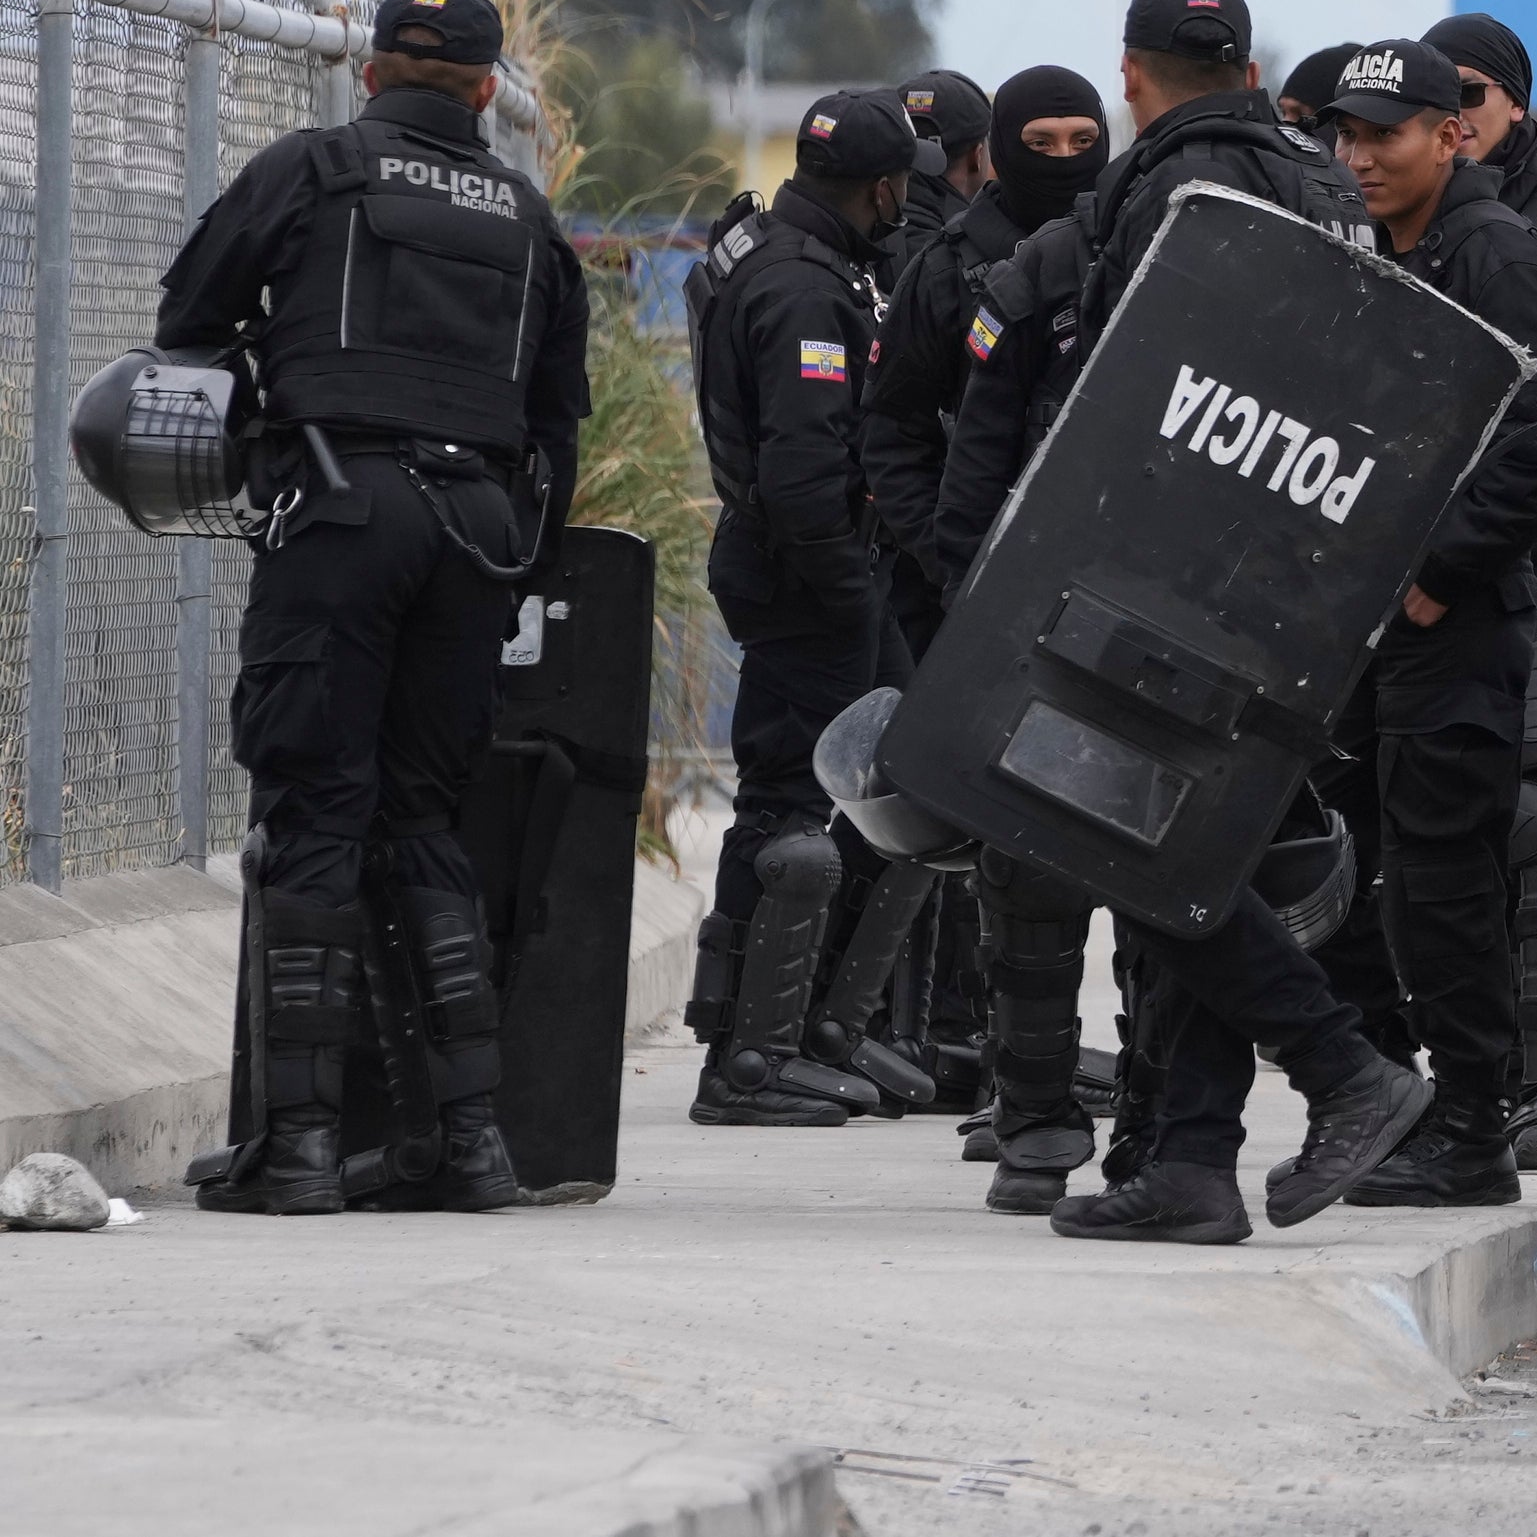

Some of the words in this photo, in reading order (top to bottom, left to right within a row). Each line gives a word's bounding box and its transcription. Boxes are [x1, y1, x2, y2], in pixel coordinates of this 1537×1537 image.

[1348, 78, 1401, 94] NACIONAL
[379, 157, 517, 208] POLICIA
[450, 194, 518, 221] NACIONAL
[803, 342, 844, 354] ECUADOR
[1159, 364, 1377, 525] POLICIA
